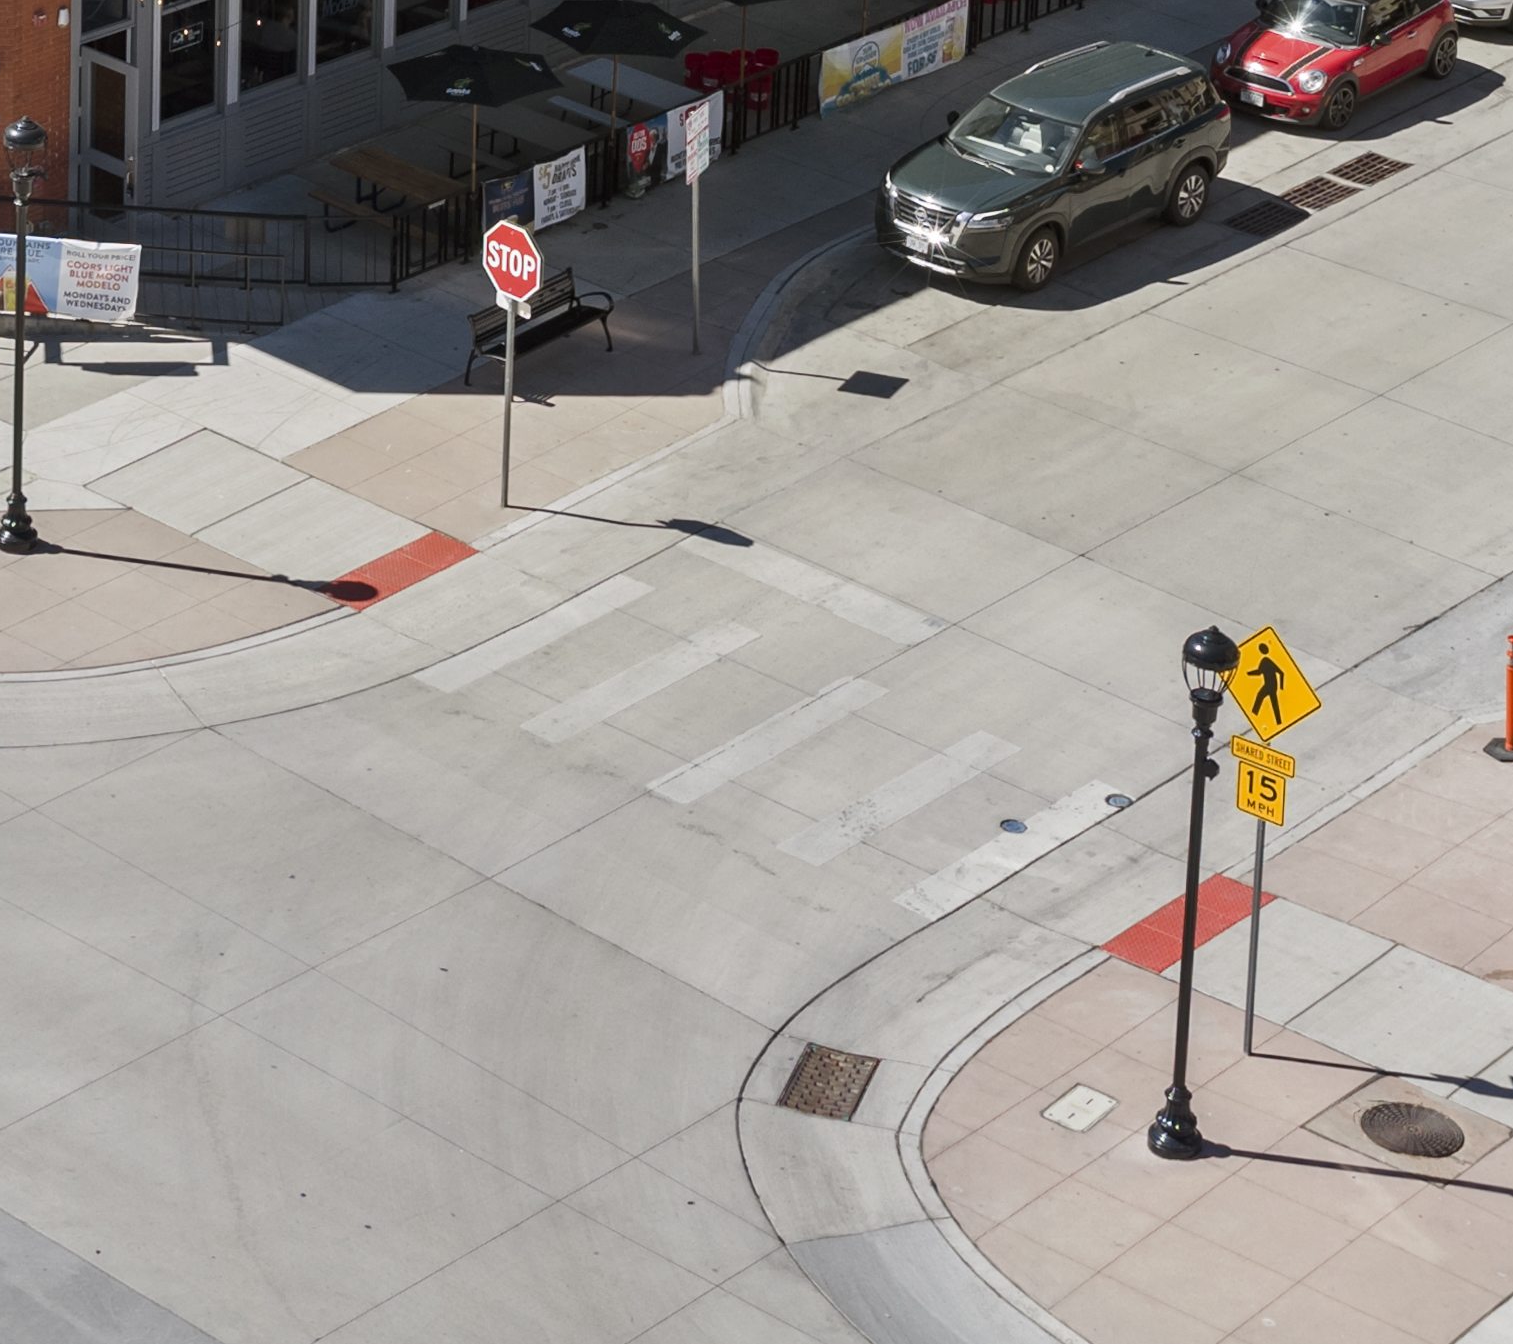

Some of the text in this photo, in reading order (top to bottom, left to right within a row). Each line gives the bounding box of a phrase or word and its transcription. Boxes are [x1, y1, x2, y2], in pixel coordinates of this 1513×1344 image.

[904, 14, 924, 33] NOW
[907, 56, 925, 76] FOR
[538, 164, 552, 189] $5
[552, 167, 577, 185] DRAFTS
[67, 250, 136, 262] ROLL YOUR PRICE!
[487, 240, 536, 281] STOP
[67, 260, 134, 274] COORS LIGHT
[69, 270, 130, 283] BLUE MOON
[75, 280, 121, 291] MODELO
[63, 291, 131, 305] MONDAYS AND
[66, 299, 127, 312] WEDNESDAYS
[1236, 742, 1291, 772] SHARED STREET
[1246, 770, 1278, 802] 15
[1247, 798, 1275, 818] MPH
